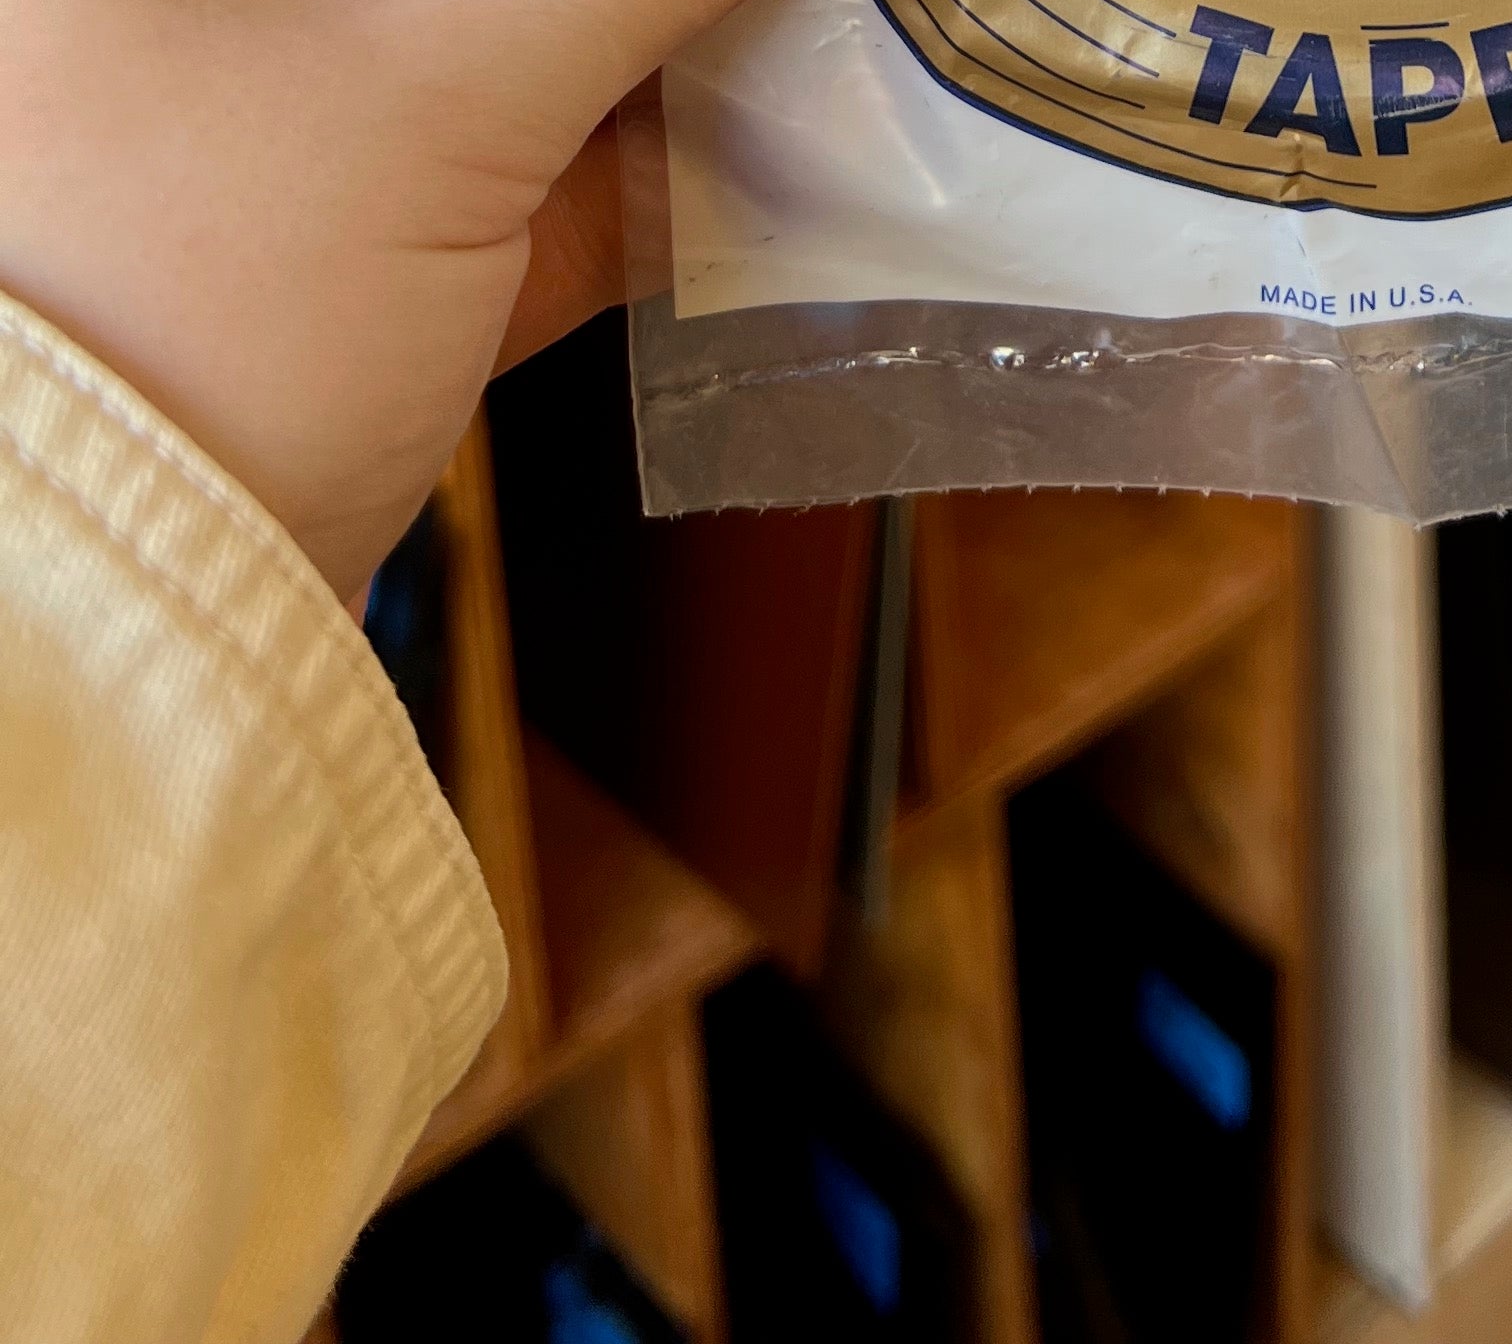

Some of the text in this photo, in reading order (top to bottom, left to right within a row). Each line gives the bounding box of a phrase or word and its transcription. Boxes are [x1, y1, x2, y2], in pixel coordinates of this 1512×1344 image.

[1260, 283, 1474, 316] MADE IN U.S.A.
